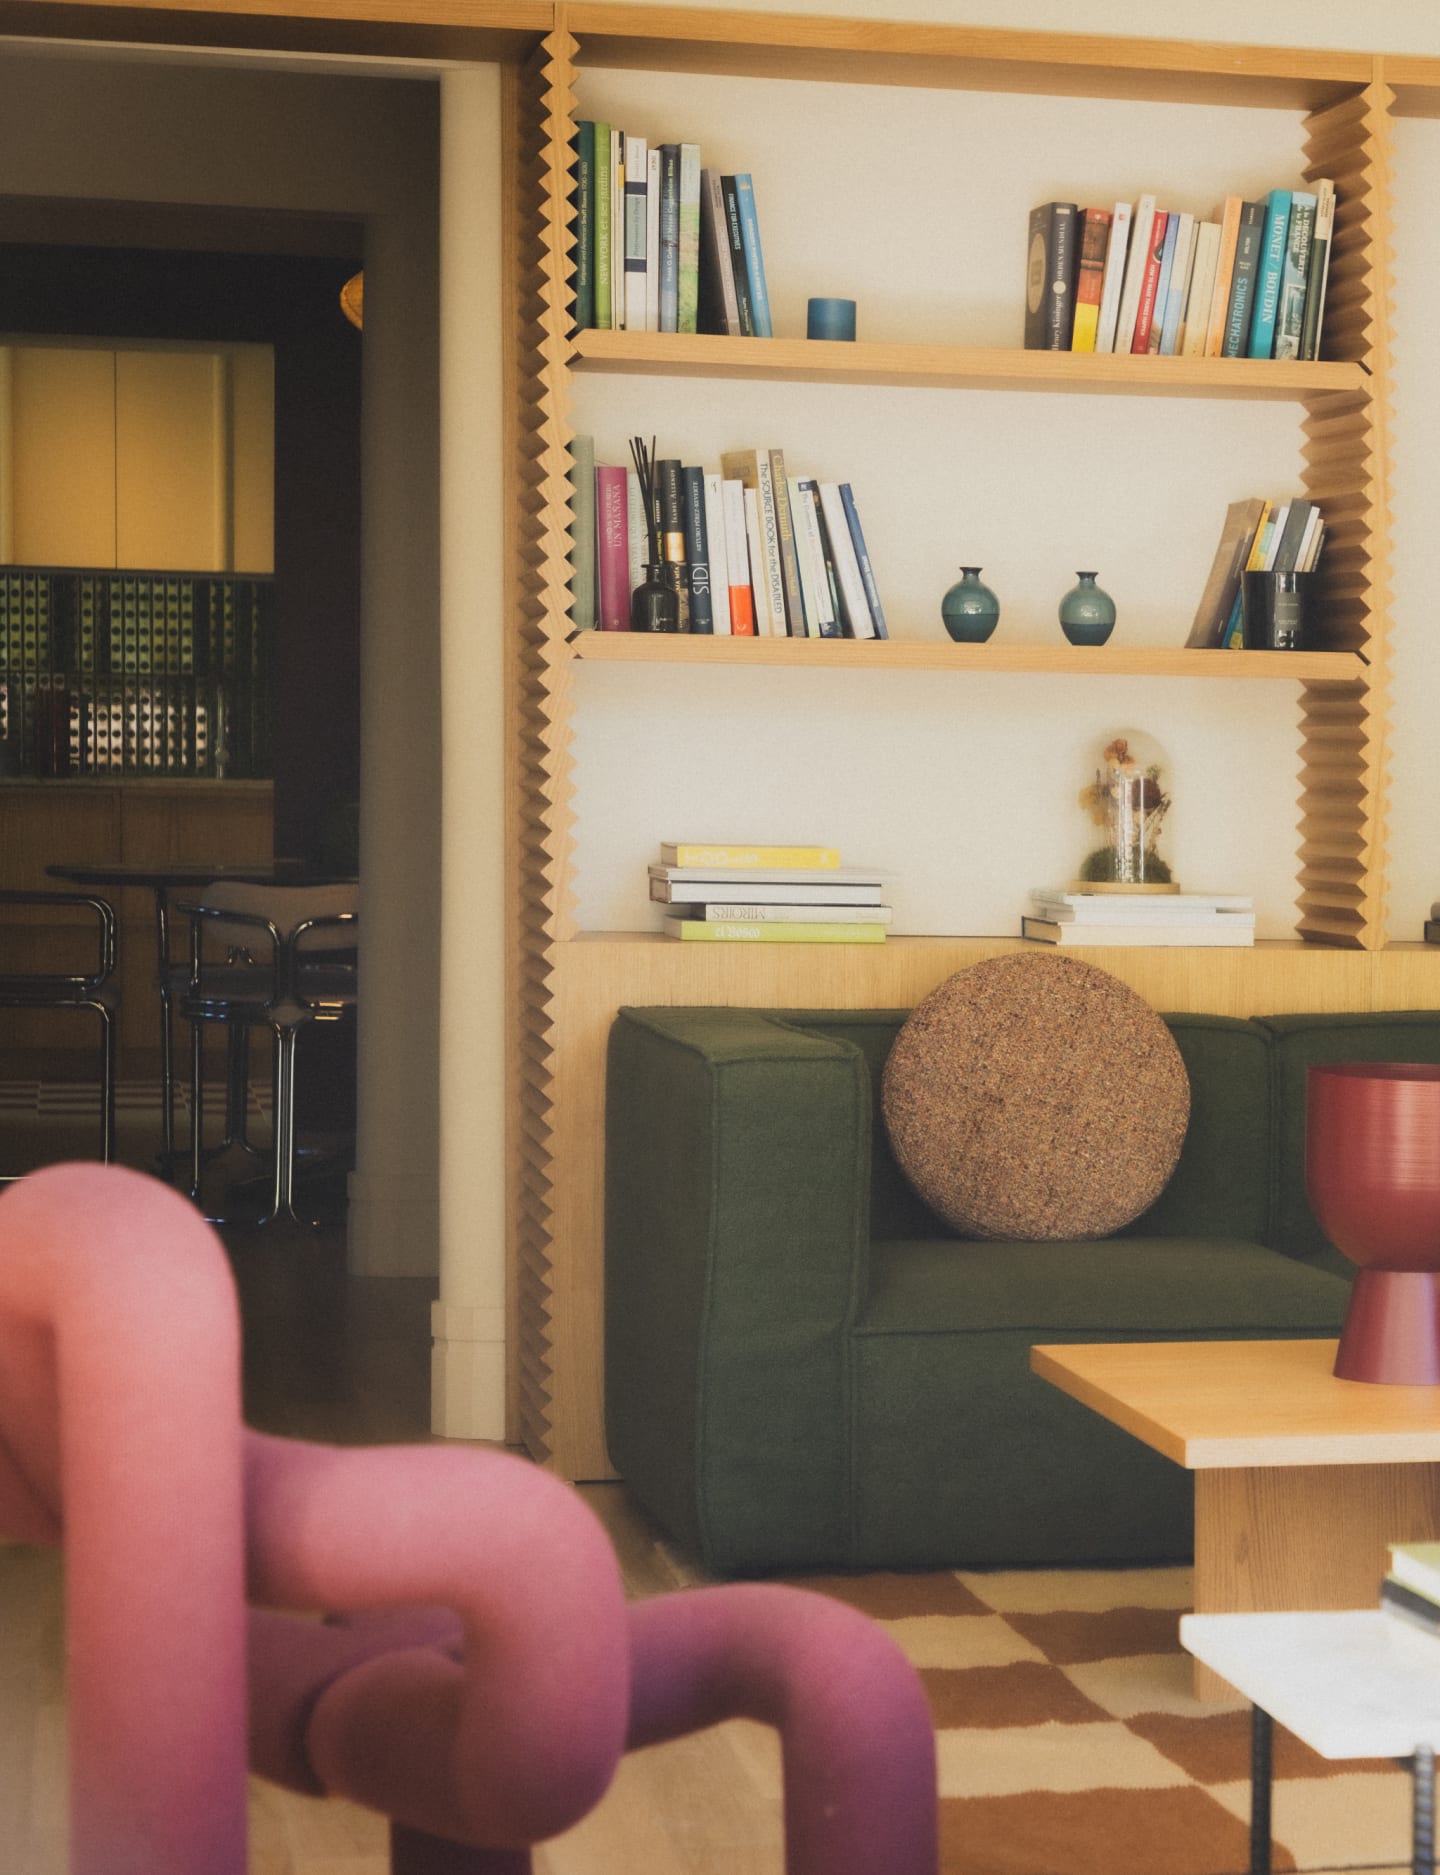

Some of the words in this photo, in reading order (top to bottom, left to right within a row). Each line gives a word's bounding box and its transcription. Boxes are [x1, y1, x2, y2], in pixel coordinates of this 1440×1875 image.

[598, 166, 610, 201] jardins
[600, 202, 608, 217] ses
[727, 193, 737, 213] FINANCE
[599, 221, 608, 230] et
[730, 213, 739, 222] FOR
[599, 232, 609, 260] YORK
[731, 222, 741, 250] EXECUTIVES
[1057, 222, 1066, 254] MUNDIAL
[1270, 214, 1286, 262] MONET
[1291, 219, 1303, 254] FRANCE
[599, 263, 609, 285] NEW
[1146, 283, 1154, 297] MAKE
[1262, 271, 1278, 324] BOUDIN
[1051, 296, 1062, 328] Kissinger
[1143, 298, 1152, 315] THINGS
[1228, 277, 1248, 358] MECHATRONICS
[1051, 329, 1062, 351] Henry
[1139, 316, 1149, 336] HAPPEN
[669, 468, 677, 499] ALLENDE
[760, 463, 769, 479] The
[773, 455, 787, 494] Charles
[693, 481, 701, 527] PÉREZ-REVERTE
[762, 480, 773, 514] SOURCE
[766, 516, 776, 544] BOOK
[777, 496, 792, 541] Demuth
[768, 545, 777, 557] for
[691, 562, 710, 595] SIDI
[769, 558, 779, 573] the
[771, 574, 782, 614] DISABLED
[712, 906, 766, 921] MIROIRS
[727, 925, 761, 939] Bosco
